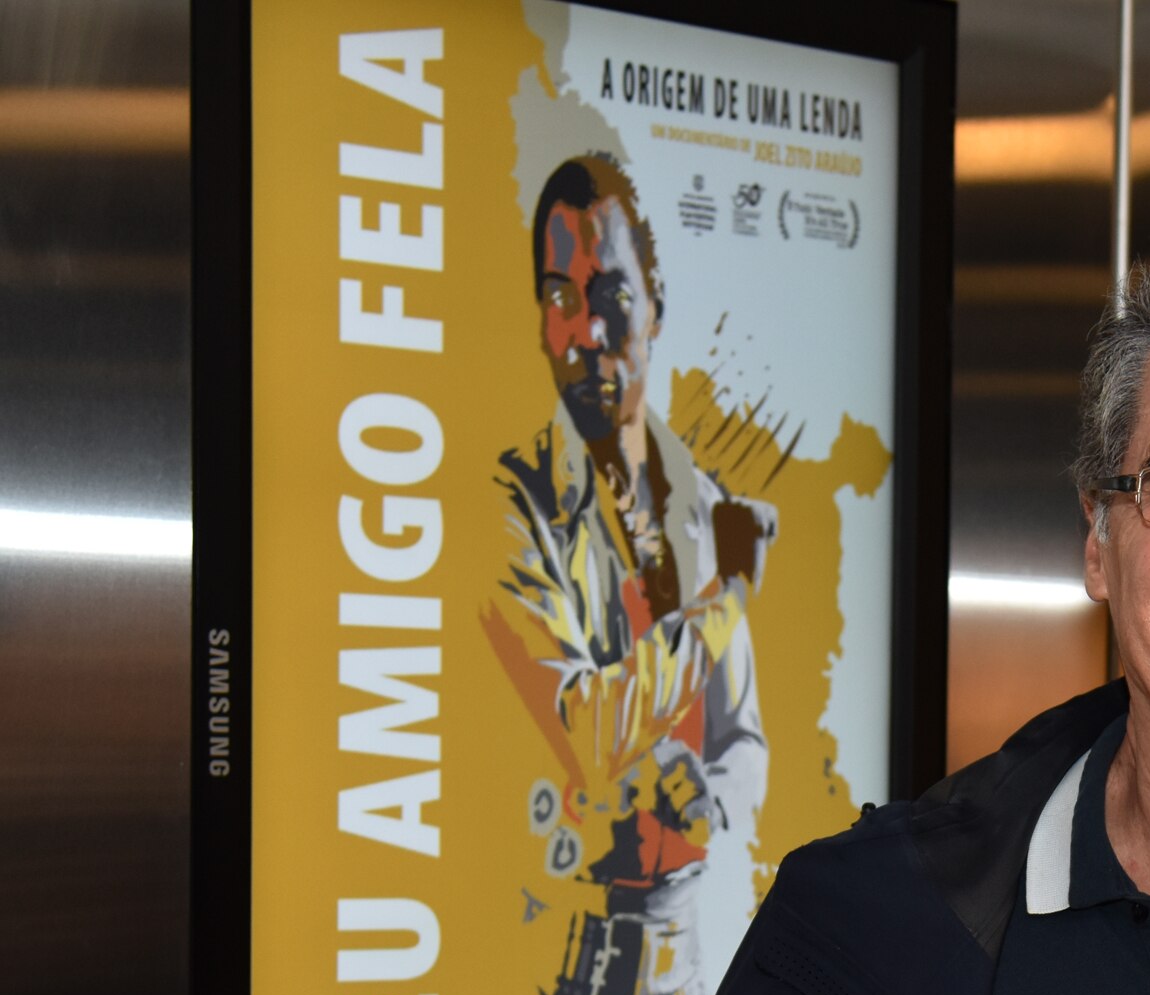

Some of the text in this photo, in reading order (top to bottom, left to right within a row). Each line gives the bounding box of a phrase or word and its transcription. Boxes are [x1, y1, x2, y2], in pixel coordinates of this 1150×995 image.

[601, 58, 863, 141] A ORIGEM DE UMA LENDA
[754, 141, 781, 166] JOEL
[339, 28, 444, 353] FELA
[338, 393, 444, 857] AMIGO
[208, 628, 231, 778] SAMSUNG
